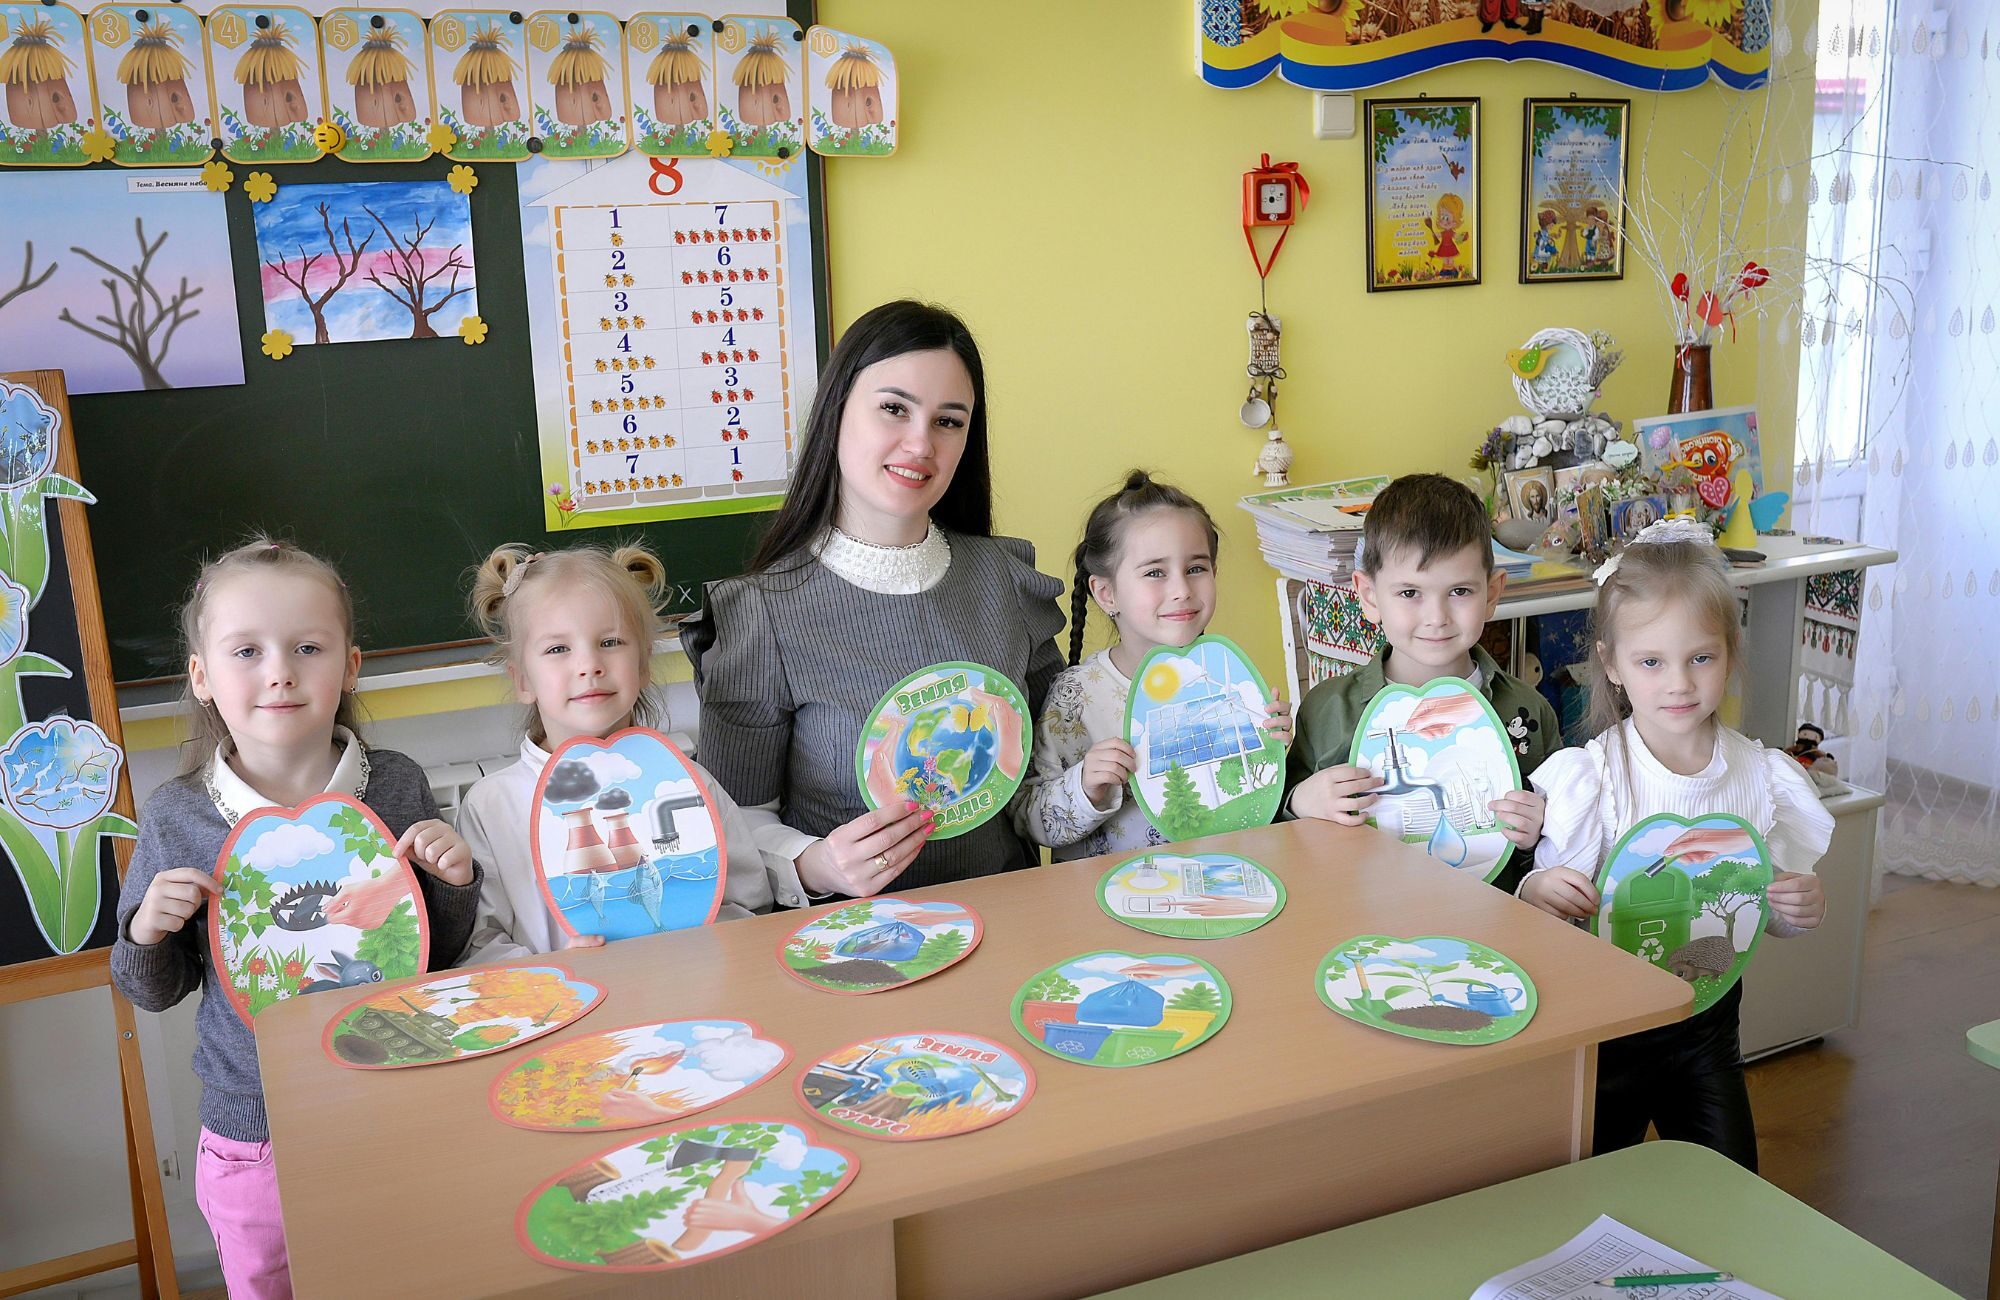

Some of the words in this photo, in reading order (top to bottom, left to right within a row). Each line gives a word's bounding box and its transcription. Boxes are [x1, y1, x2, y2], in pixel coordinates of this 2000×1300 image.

[100, 12, 121, 44] 3
[220, 15, 240, 44] 4
[331, 18, 350, 47] 5
[444, 19, 461, 47] 6
[536, 20, 552, 49] 7
[635, 19, 651, 48] 8
[723, 22, 739, 51] 9
[813, 30, 837, 54] 10
[155, 180, 188, 188] Весняне
[189, 179, 208, 187] небо
[648, 157, 684, 196] 8
[609, 209, 623, 228] 1
[714, 206, 728, 225] 7
[611, 251, 626, 270] 2
[717, 246, 731, 265] 6
[614, 292, 628, 311] 3
[720, 287, 733, 306] 5
[616, 333, 632, 353] 4
[721, 327, 736, 346] 4
[621, 375, 634, 393] 5
[724, 368, 738, 386] 3
[623, 414, 637, 433] 6
[727, 407, 741, 425] 2
[625, 455, 640, 473] 7
[730, 446, 742, 465] 1
[896, 672, 968, 715] ЗЕМЛЯ
[932, 789, 992, 831] РАДІЄ
[913, 1036, 1001, 1064] ЗЕМЛЯ
[828, 1107, 912, 1134] СУМУЄ
